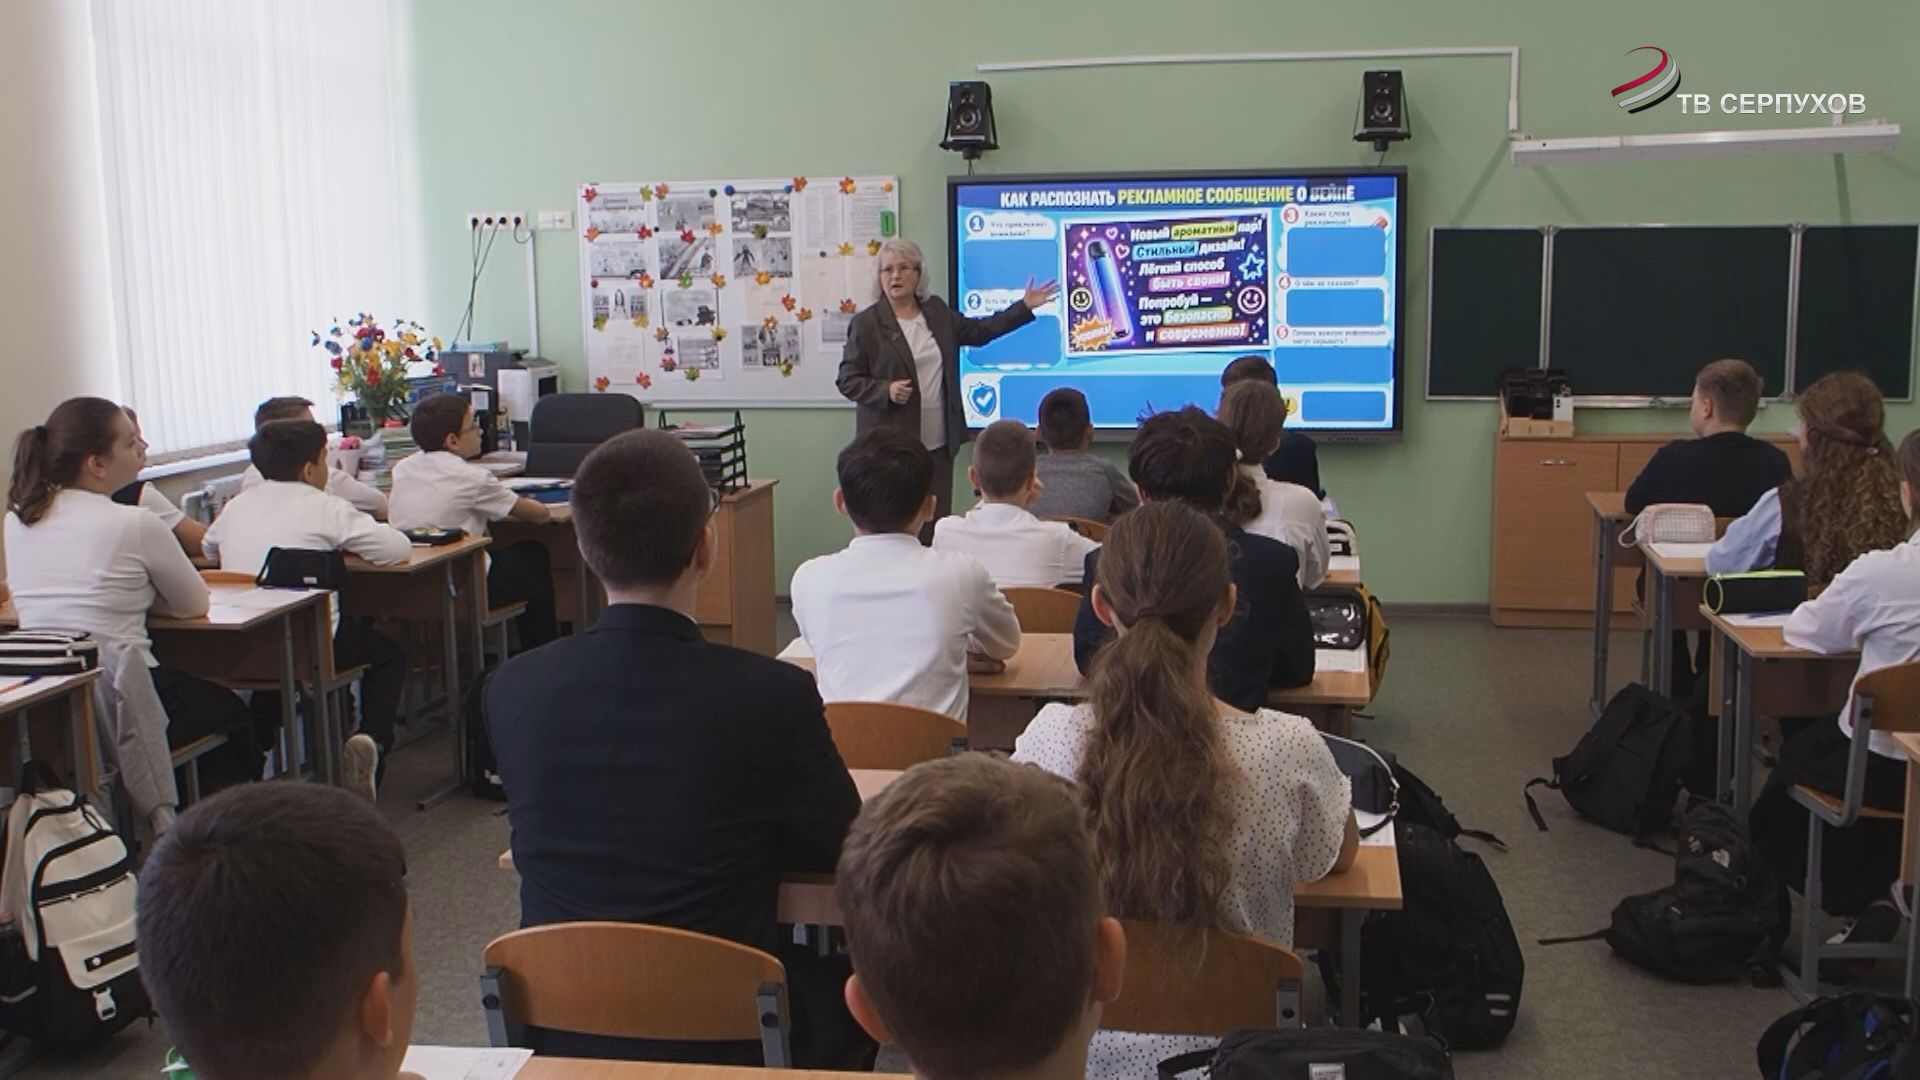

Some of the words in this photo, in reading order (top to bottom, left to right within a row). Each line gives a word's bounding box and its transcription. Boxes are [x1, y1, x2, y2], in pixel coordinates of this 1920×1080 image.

[1000, 191, 1029, 208] КАК
[1030, 190, 1115, 208] РАСПОЗНАТЬ
[1117, 187, 1203, 205] РЕКЛАМНОЕ
[1206, 186, 1294, 204] СООБЩЕНИЕ
[1296, 186, 1307, 202] О
[1130, 227, 1170, 242] Новый
[1173, 224, 1235, 238] ароматный
[1238, 218, 1262, 234] пар!
[1136, 242, 1196, 258] Стильный
[1199, 238, 1246, 255] дизайн!
[1139, 261, 1182, 276] Лёгкий
[1183, 257, 1225, 272] способ
[1152, 277, 1184, 290] быть
[1186, 271, 1231, 287] своим!
[1138, 293, 1199, 310] Попробуй
[1140, 314, 1162, 326] это
[1145, 331, 1155, 342] и
[1160, 323, 1246, 342] современно!
